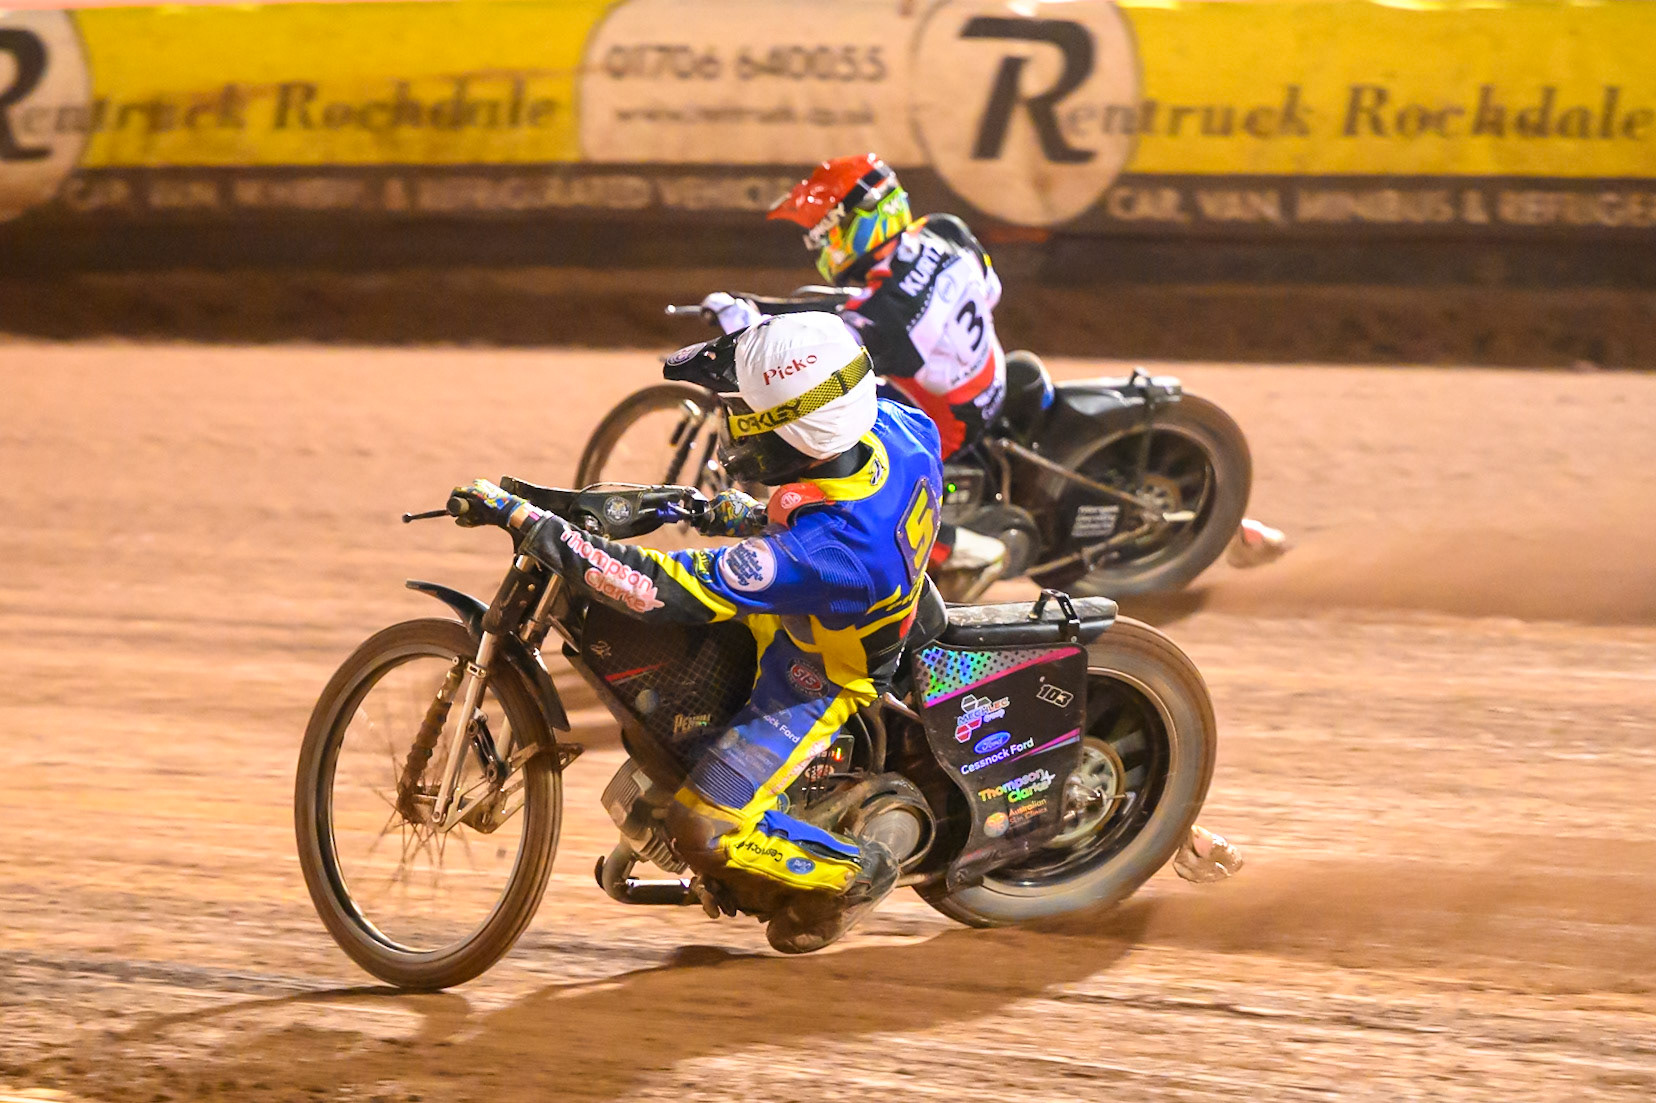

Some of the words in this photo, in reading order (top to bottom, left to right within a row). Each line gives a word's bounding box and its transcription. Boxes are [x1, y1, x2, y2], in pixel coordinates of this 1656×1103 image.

[1343, 82, 1656, 140] Rochdale
[956, 299, 985, 352] 3
[763, 354, 818, 386] Picko
[737, 398, 800, 433] OAKLEY
[904, 487, 934, 570] 5
[560, 524, 654, 594] Thompson
[1036, 684, 1074, 708] 103
[779, 724, 802, 744] Ford
[960, 748, 1010, 776] Cessnock
[1010, 737, 1035, 756] Ford
[977, 768, 1045, 802] Thompson
